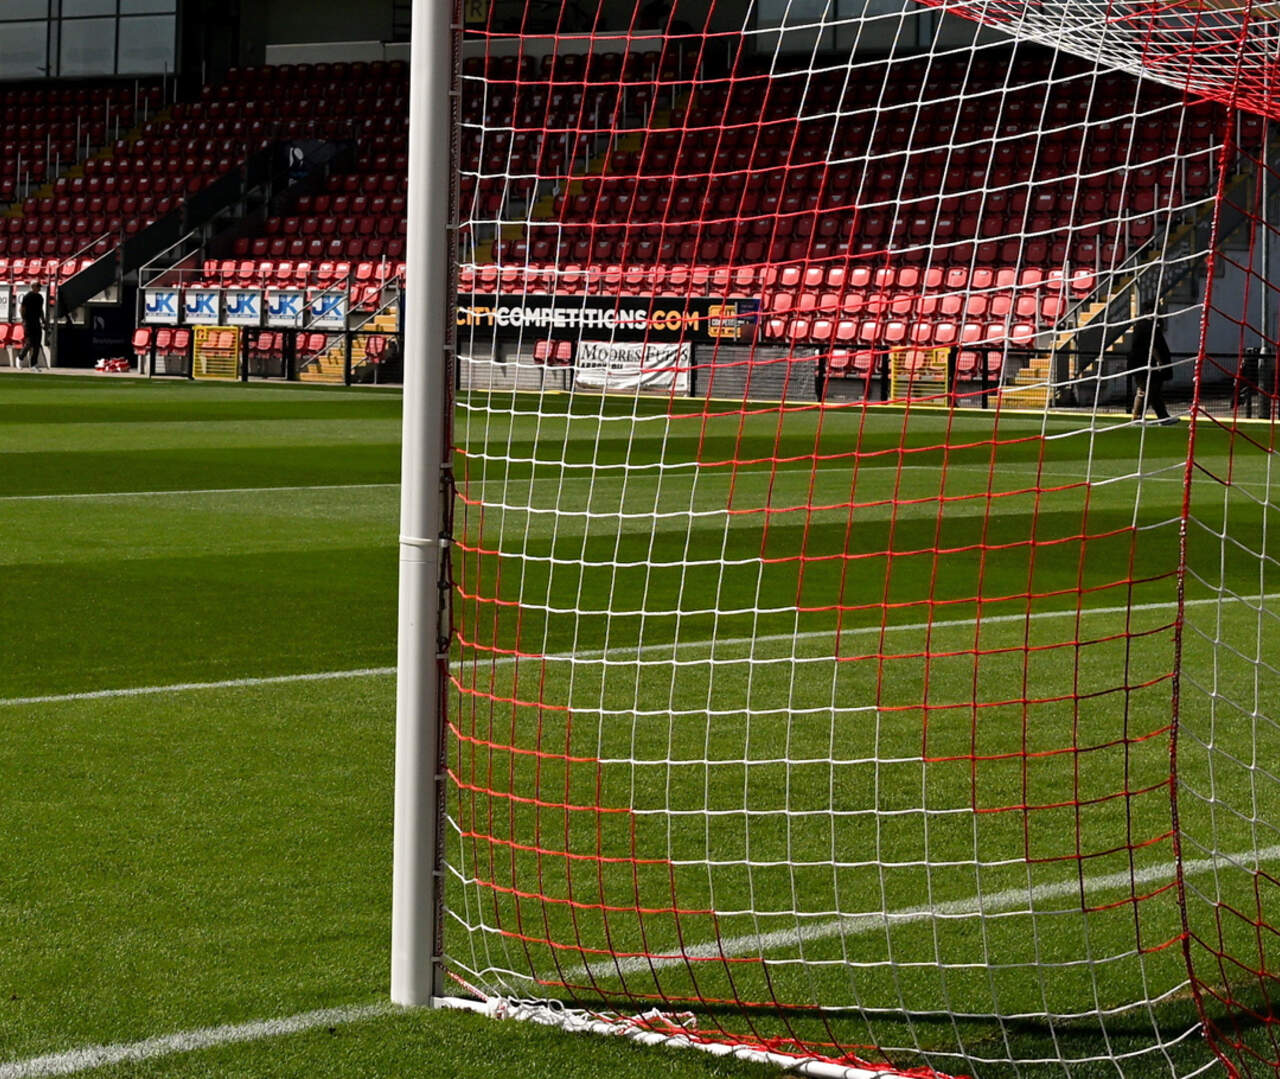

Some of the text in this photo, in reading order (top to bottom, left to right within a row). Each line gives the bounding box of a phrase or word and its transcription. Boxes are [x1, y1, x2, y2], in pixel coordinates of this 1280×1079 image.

[146, 292, 175, 313] JK
[186, 293, 215, 314] JK
[227, 294, 257, 315] JK
[270, 294, 300, 316] JK
[312, 295, 343, 318] JK
[456, 306, 699, 331] CITYCOMPETITIONS.COM
